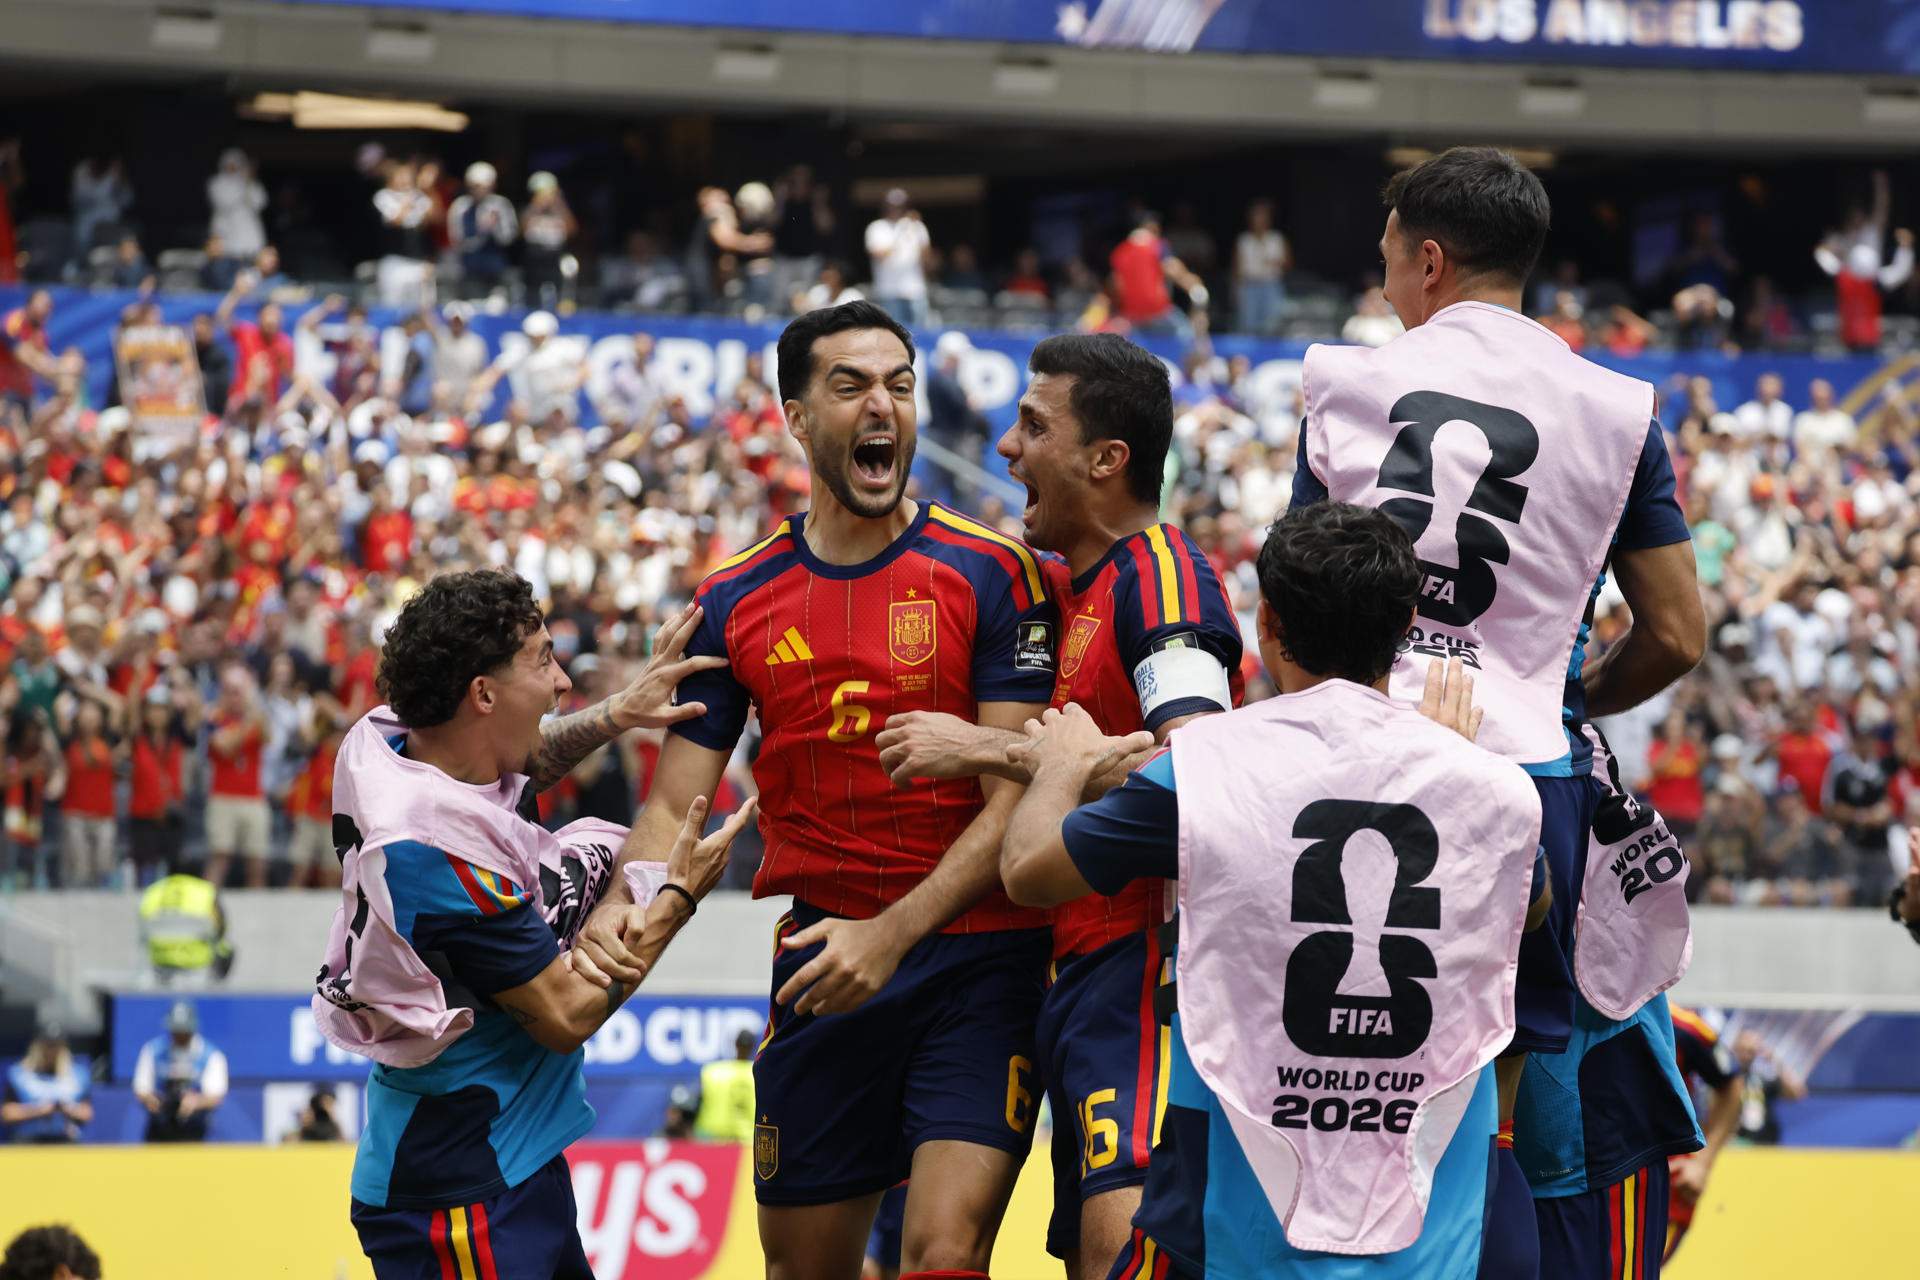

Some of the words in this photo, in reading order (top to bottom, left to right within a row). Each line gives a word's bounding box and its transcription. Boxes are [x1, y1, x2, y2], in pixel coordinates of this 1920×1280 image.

[1423, 0, 1537, 43] LOS
[1542, 0, 1803, 51] ANGELES
[1420, 574, 1455, 605] FA
[827, 680, 871, 742] 6
[1610, 828, 1670, 877] WORL
[1620, 846, 1684, 905] 20
[1329, 1008, 1393, 1035] FIFA
[1005, 1054, 1032, 1134] 6
[1277, 1066, 1370, 1091] WORLD
[1374, 1071, 1424, 1092] CUP
[1078, 1088, 1119, 1179] 16
[1271, 1094, 1419, 1134] 2026
[573, 1137, 708, 1280] y's
